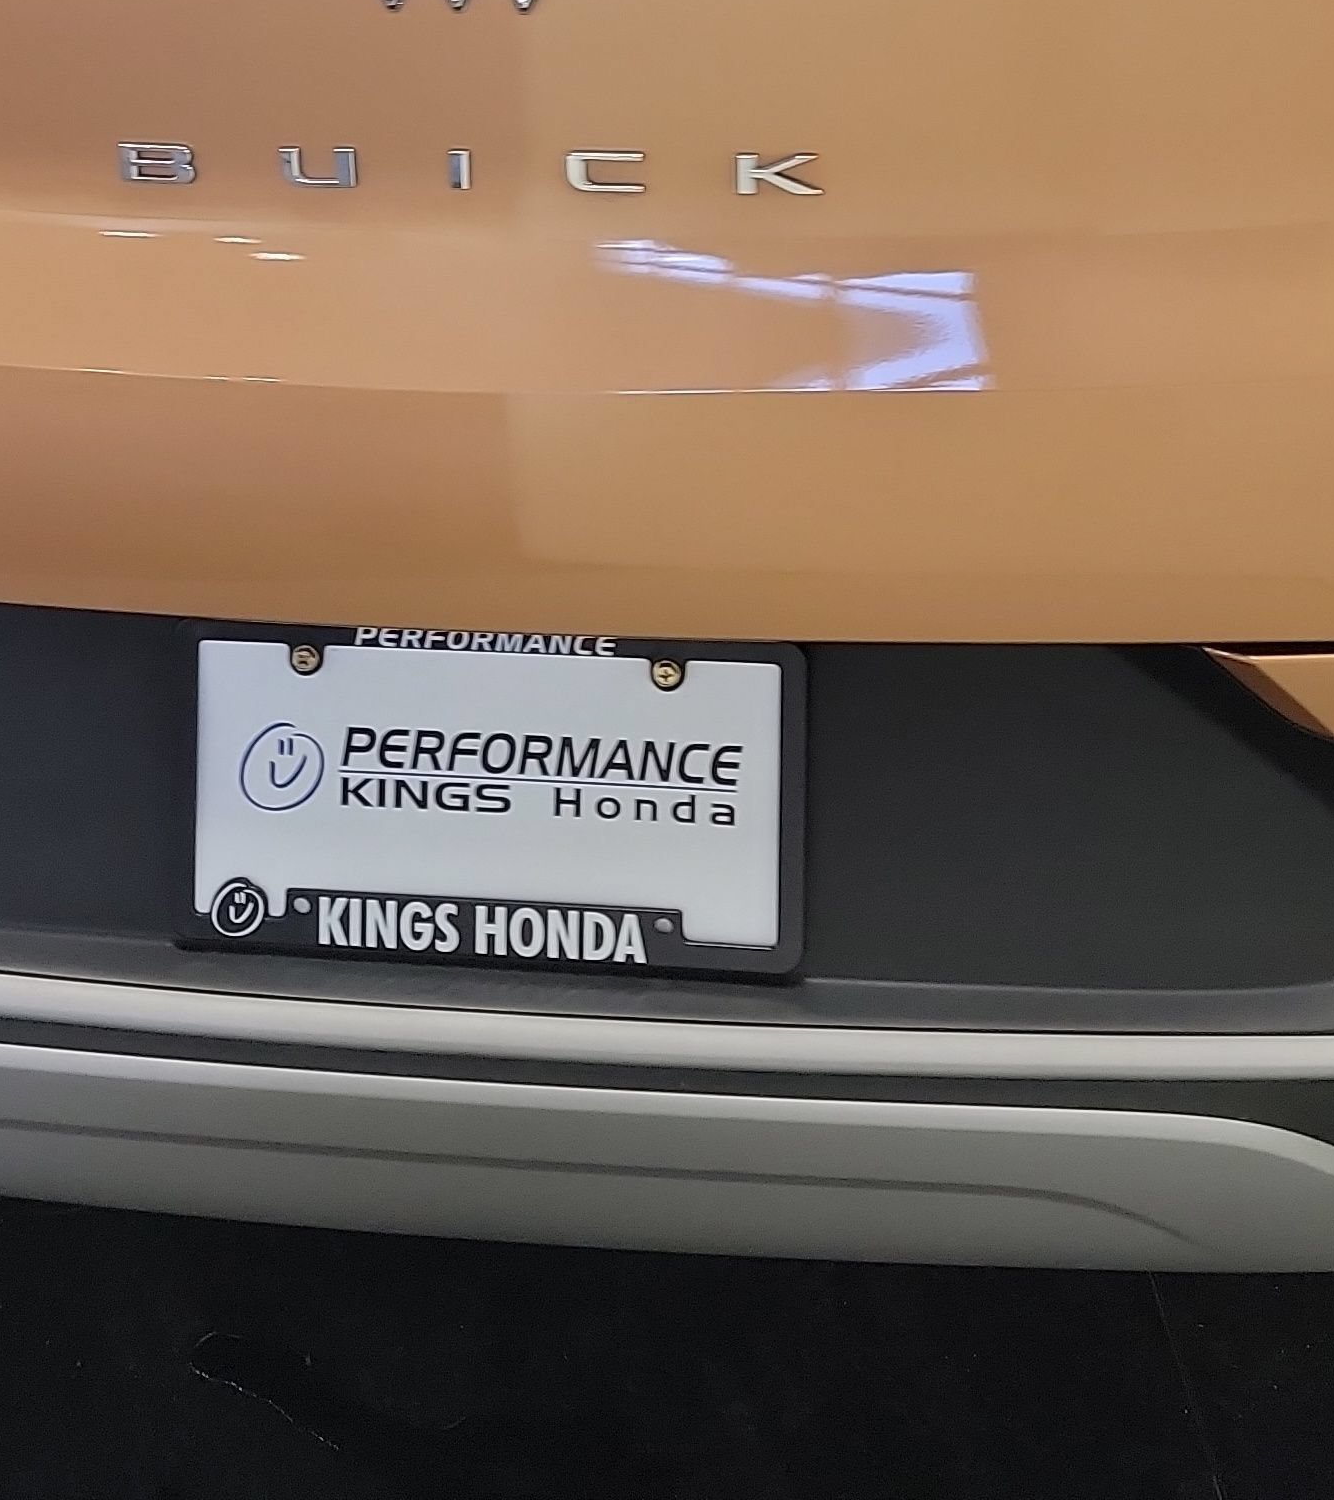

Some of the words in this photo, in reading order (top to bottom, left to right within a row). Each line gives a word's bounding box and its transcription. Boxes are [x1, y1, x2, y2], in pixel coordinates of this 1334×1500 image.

[118, 141, 825, 196] BUICK
[354, 626, 618, 657] PERFORMANCE
[342, 726, 744, 787] PERFORMANCE
[340, 777, 512, 814] KINGS
[554, 787, 737, 826] Honda
[317, 896, 461, 955] KINGS
[474, 904, 648, 964] HONDA
